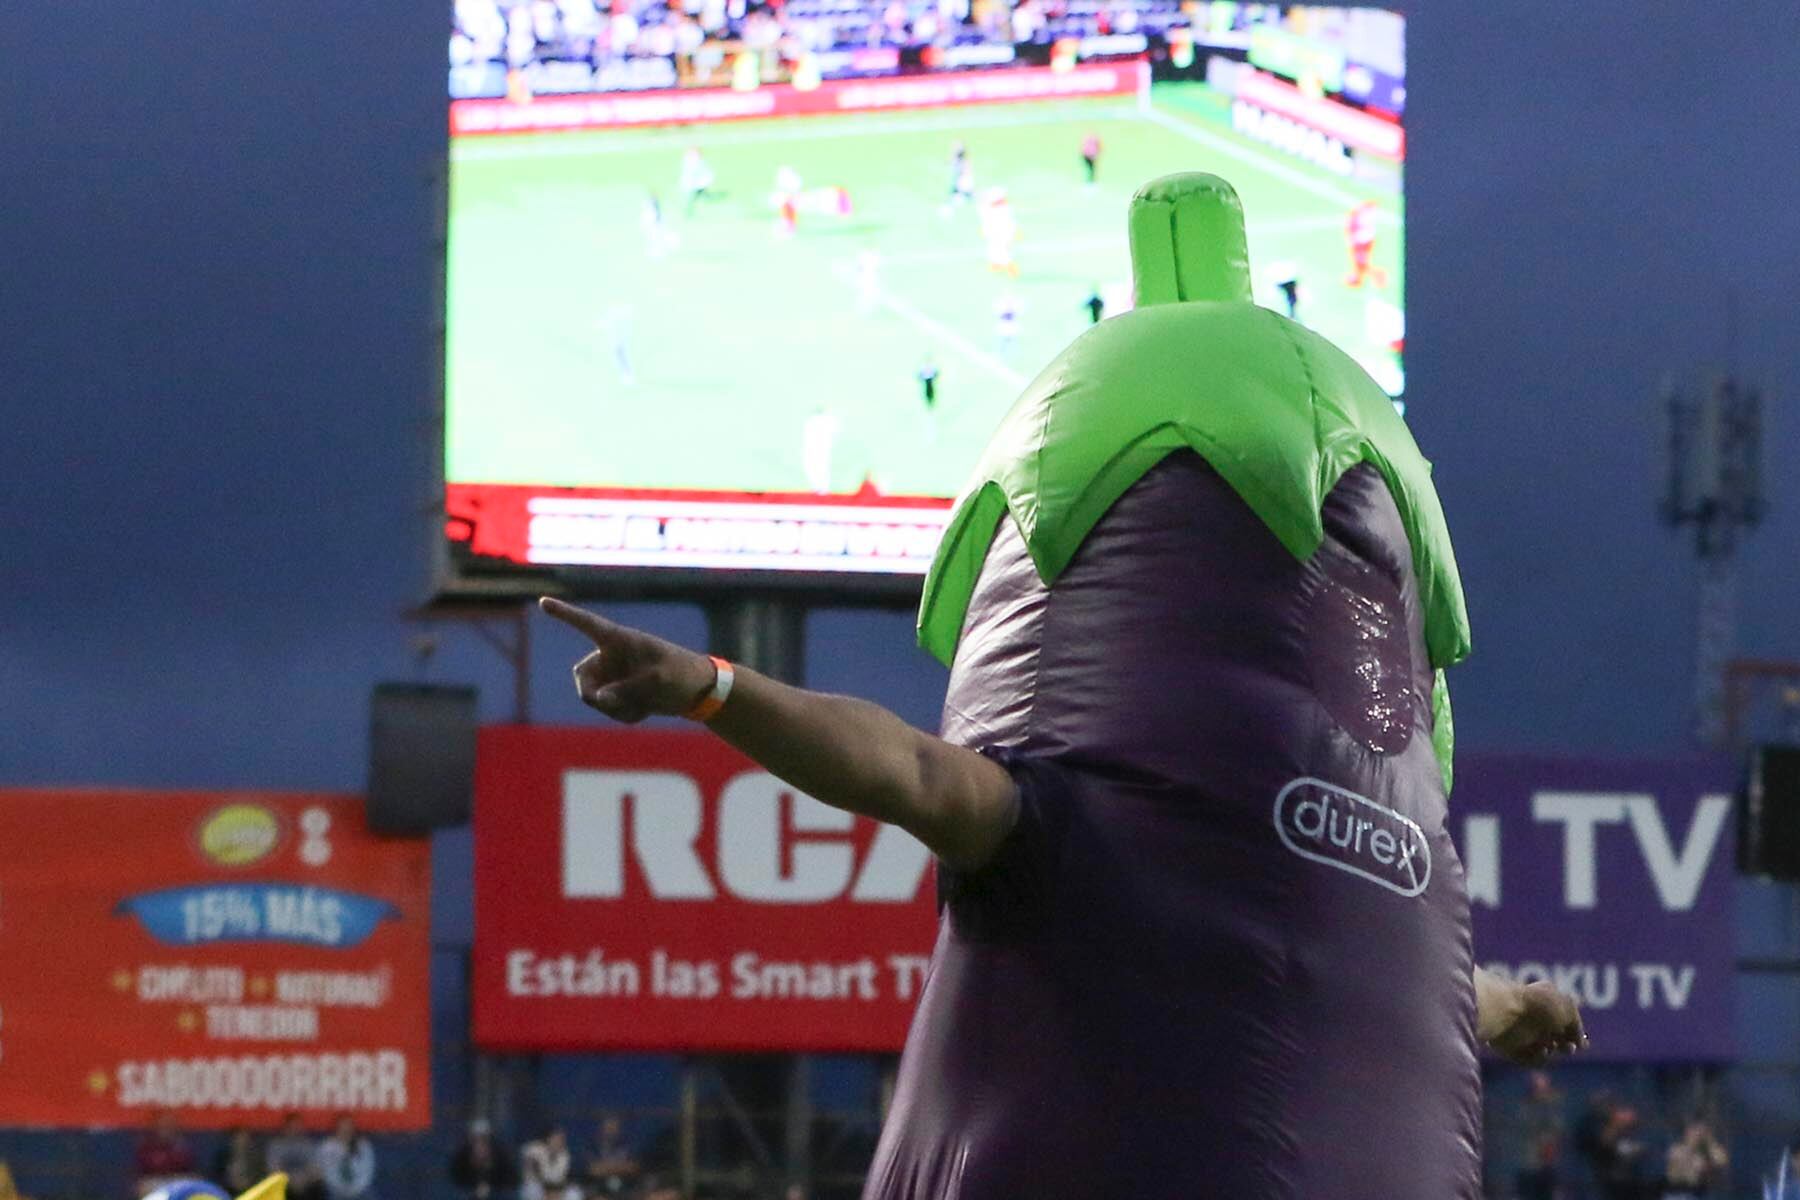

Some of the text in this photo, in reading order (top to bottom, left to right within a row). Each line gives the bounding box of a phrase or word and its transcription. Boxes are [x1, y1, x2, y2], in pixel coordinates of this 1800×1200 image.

[1293, 795, 1421, 891] durex
[1530, 791, 1734, 912] TV
[506, 946, 640, 998] Están
[651, 948, 722, 1000] las
[729, 950, 879, 1001] Smart
[1628, 964, 1697, 1010] TV
